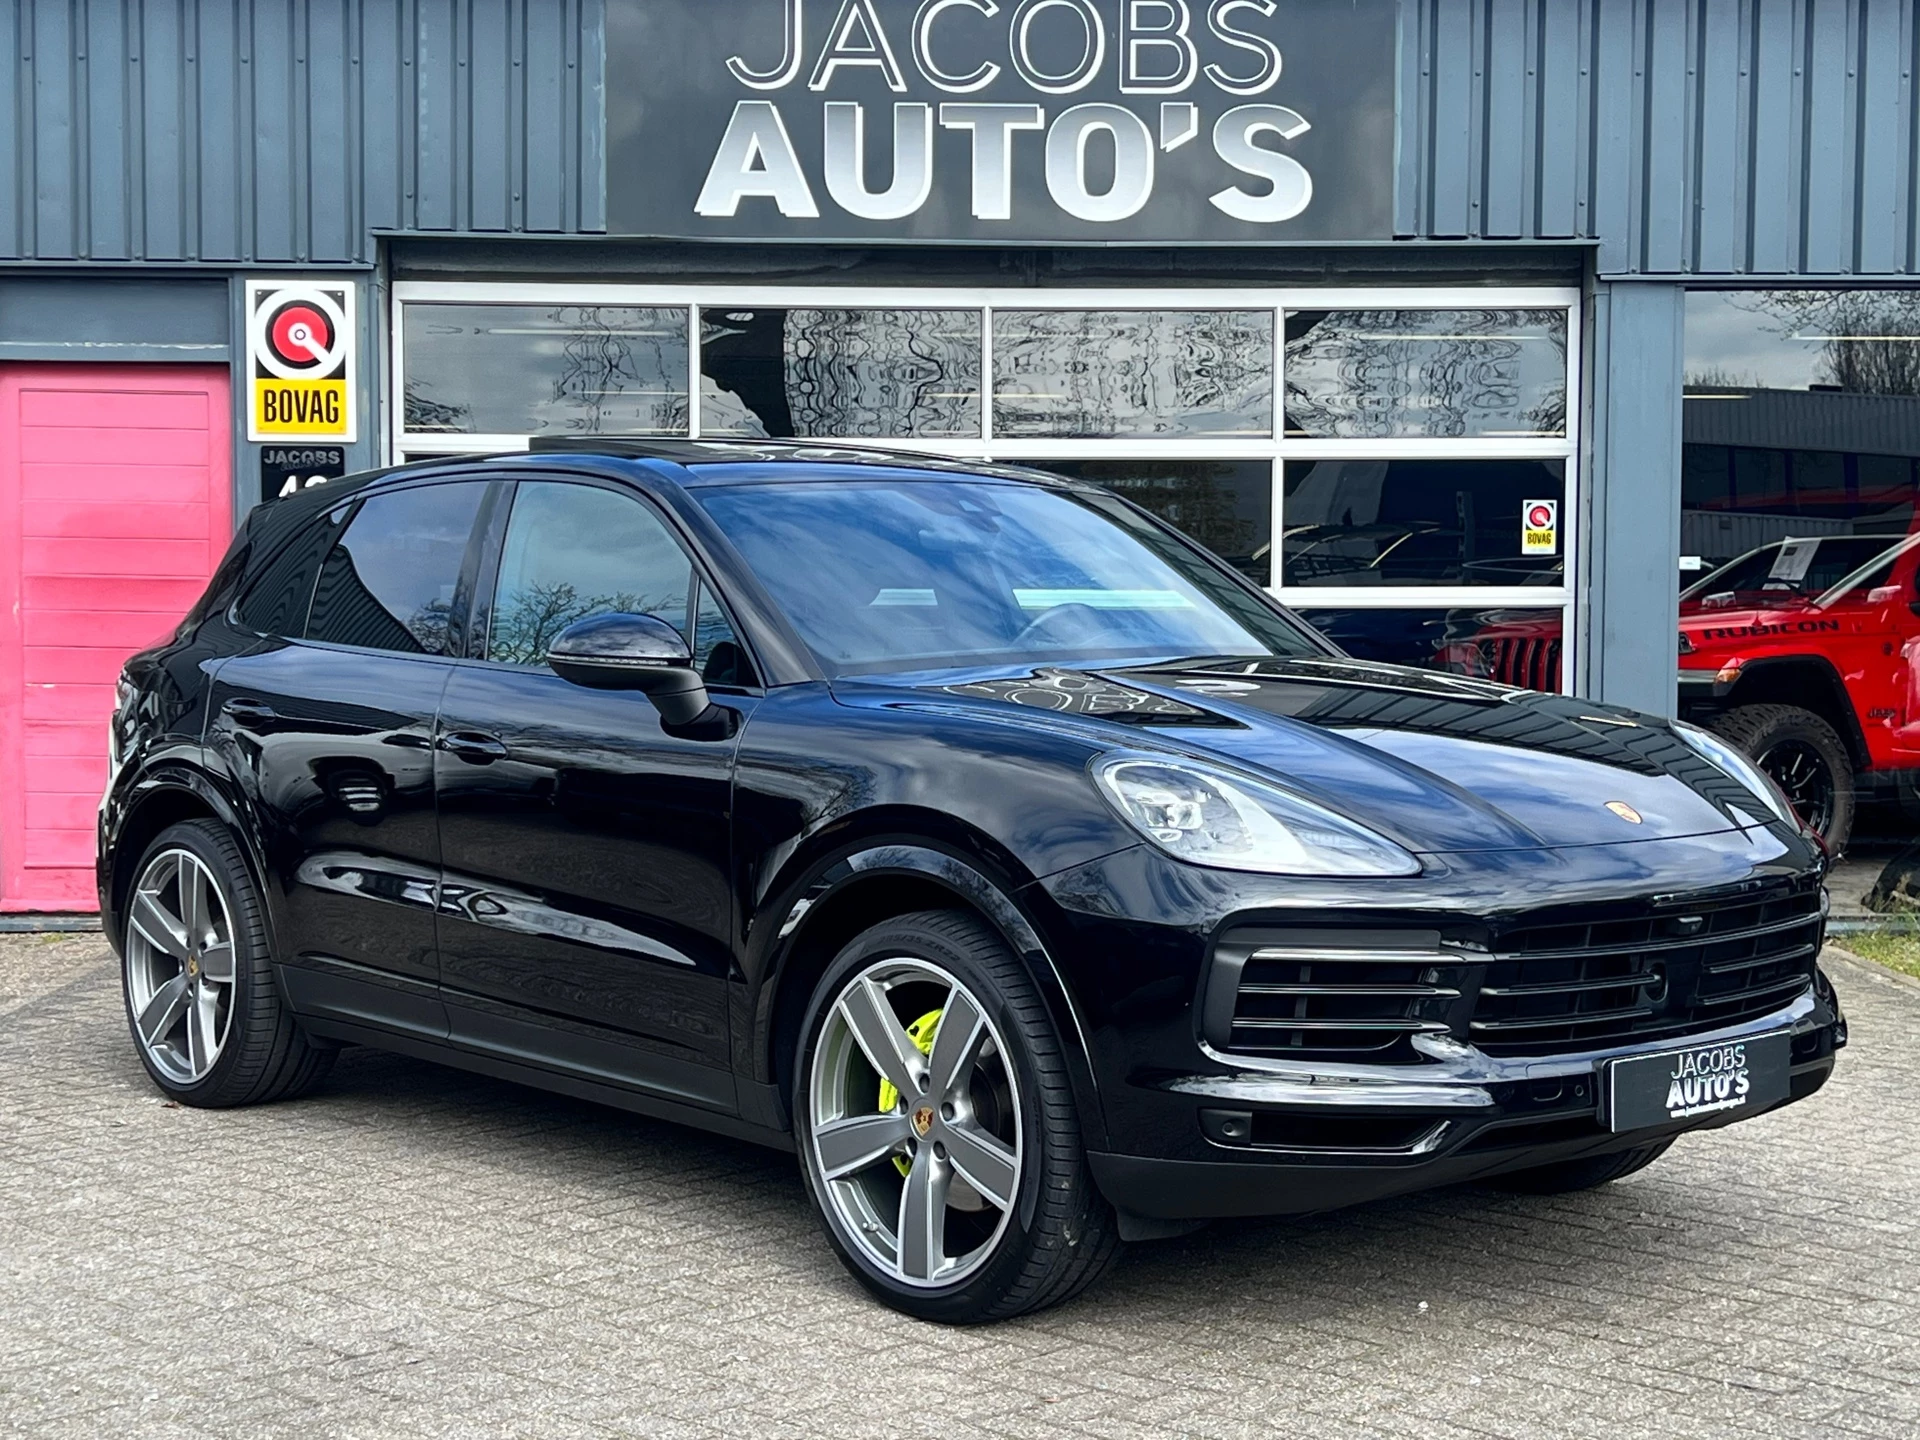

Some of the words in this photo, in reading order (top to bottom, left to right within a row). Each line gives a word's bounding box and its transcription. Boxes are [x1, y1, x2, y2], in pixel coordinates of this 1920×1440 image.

[725, 0, 1282, 95] JACOBS
[694, 100, 1312, 222] AUTO'S
[263, 389, 339, 424] BOVAG
[264, 450, 340, 464] JACOBS
[1527, 532, 1552, 545] BOVAG
[1703, 620, 1839, 640] RUBICON
[1670, 1044, 1746, 1079] JACOBS
[1665, 1067, 1750, 1109] AUTO'S
